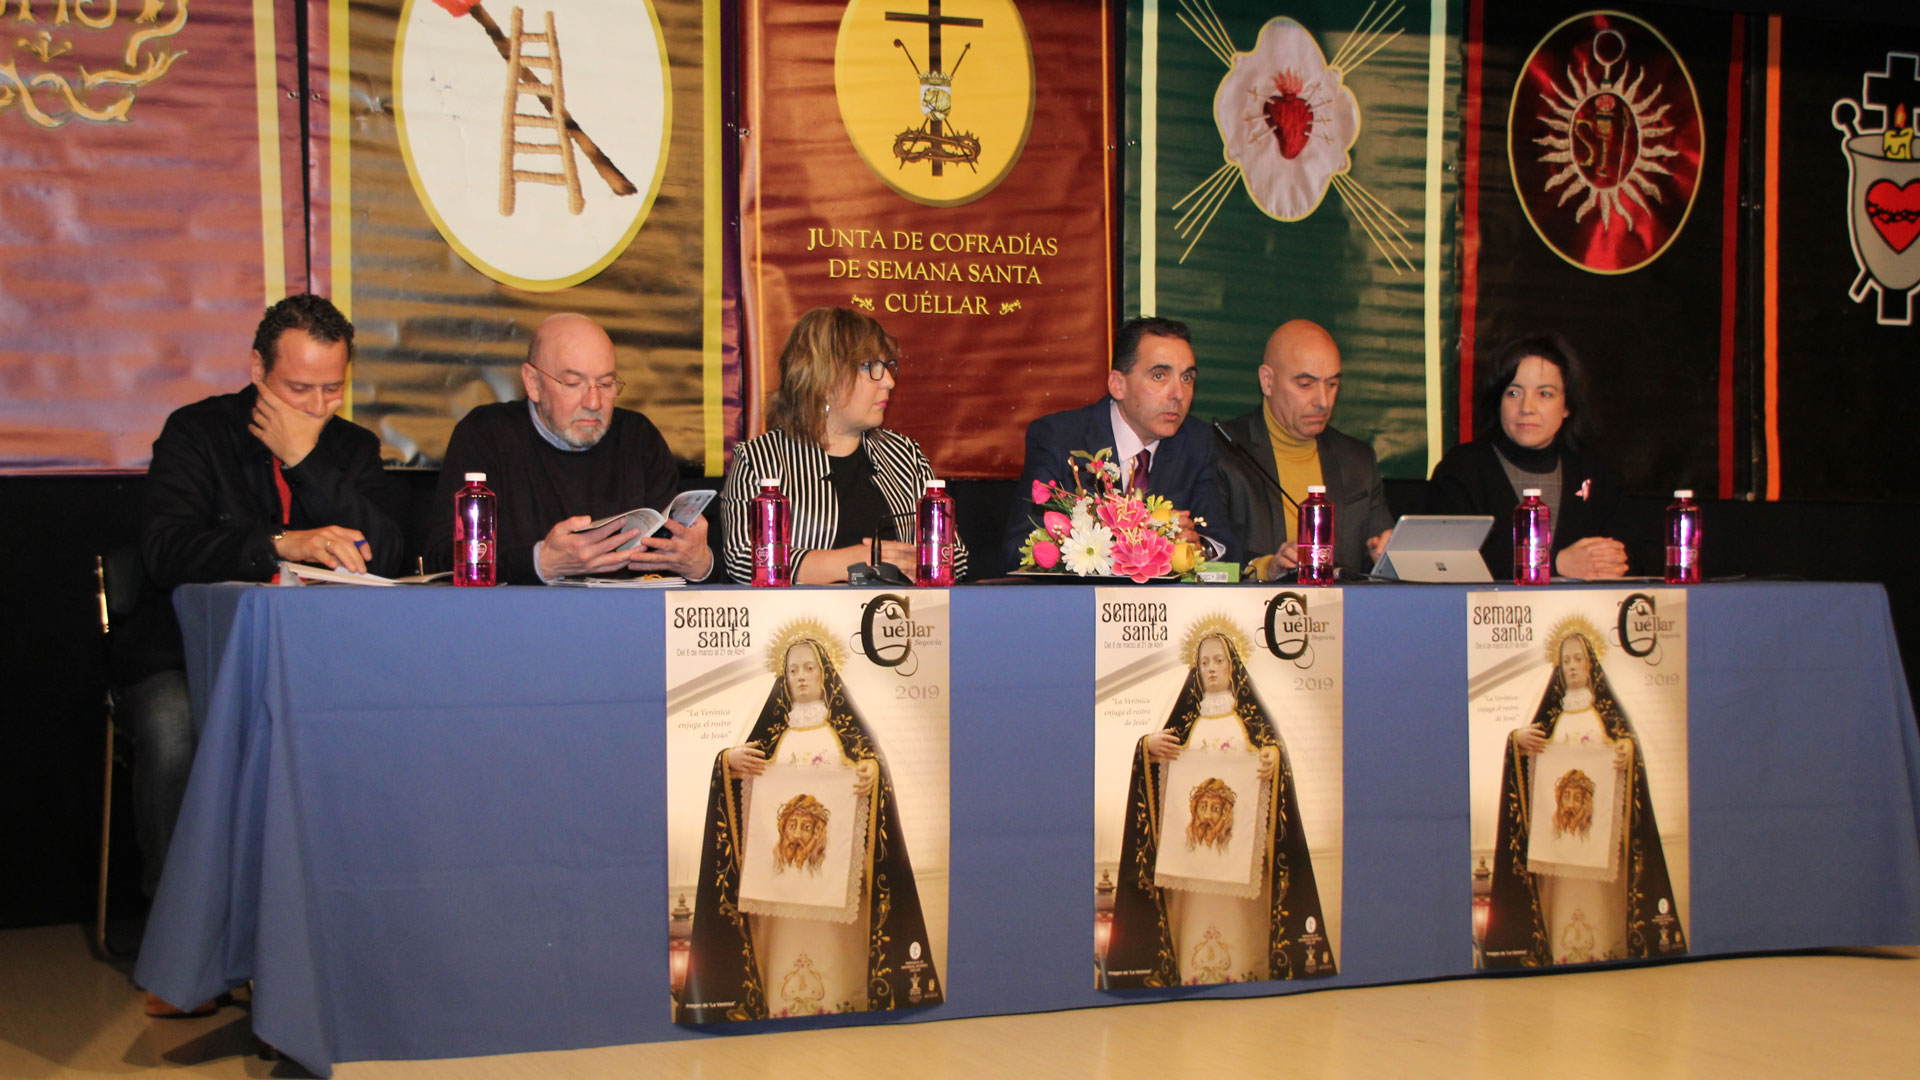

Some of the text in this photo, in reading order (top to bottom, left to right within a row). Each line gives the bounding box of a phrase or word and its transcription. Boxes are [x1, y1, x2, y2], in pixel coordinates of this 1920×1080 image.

[807, 227, 1058, 256] JUNTA DE COFRADÍAS
[828, 258, 1042, 285] DE SEMANA SANTA
[884, 290, 990, 316] CUÉLLAR
[894, 685, 940, 700] 2019
[1293, 677, 1334, 691] 2019
